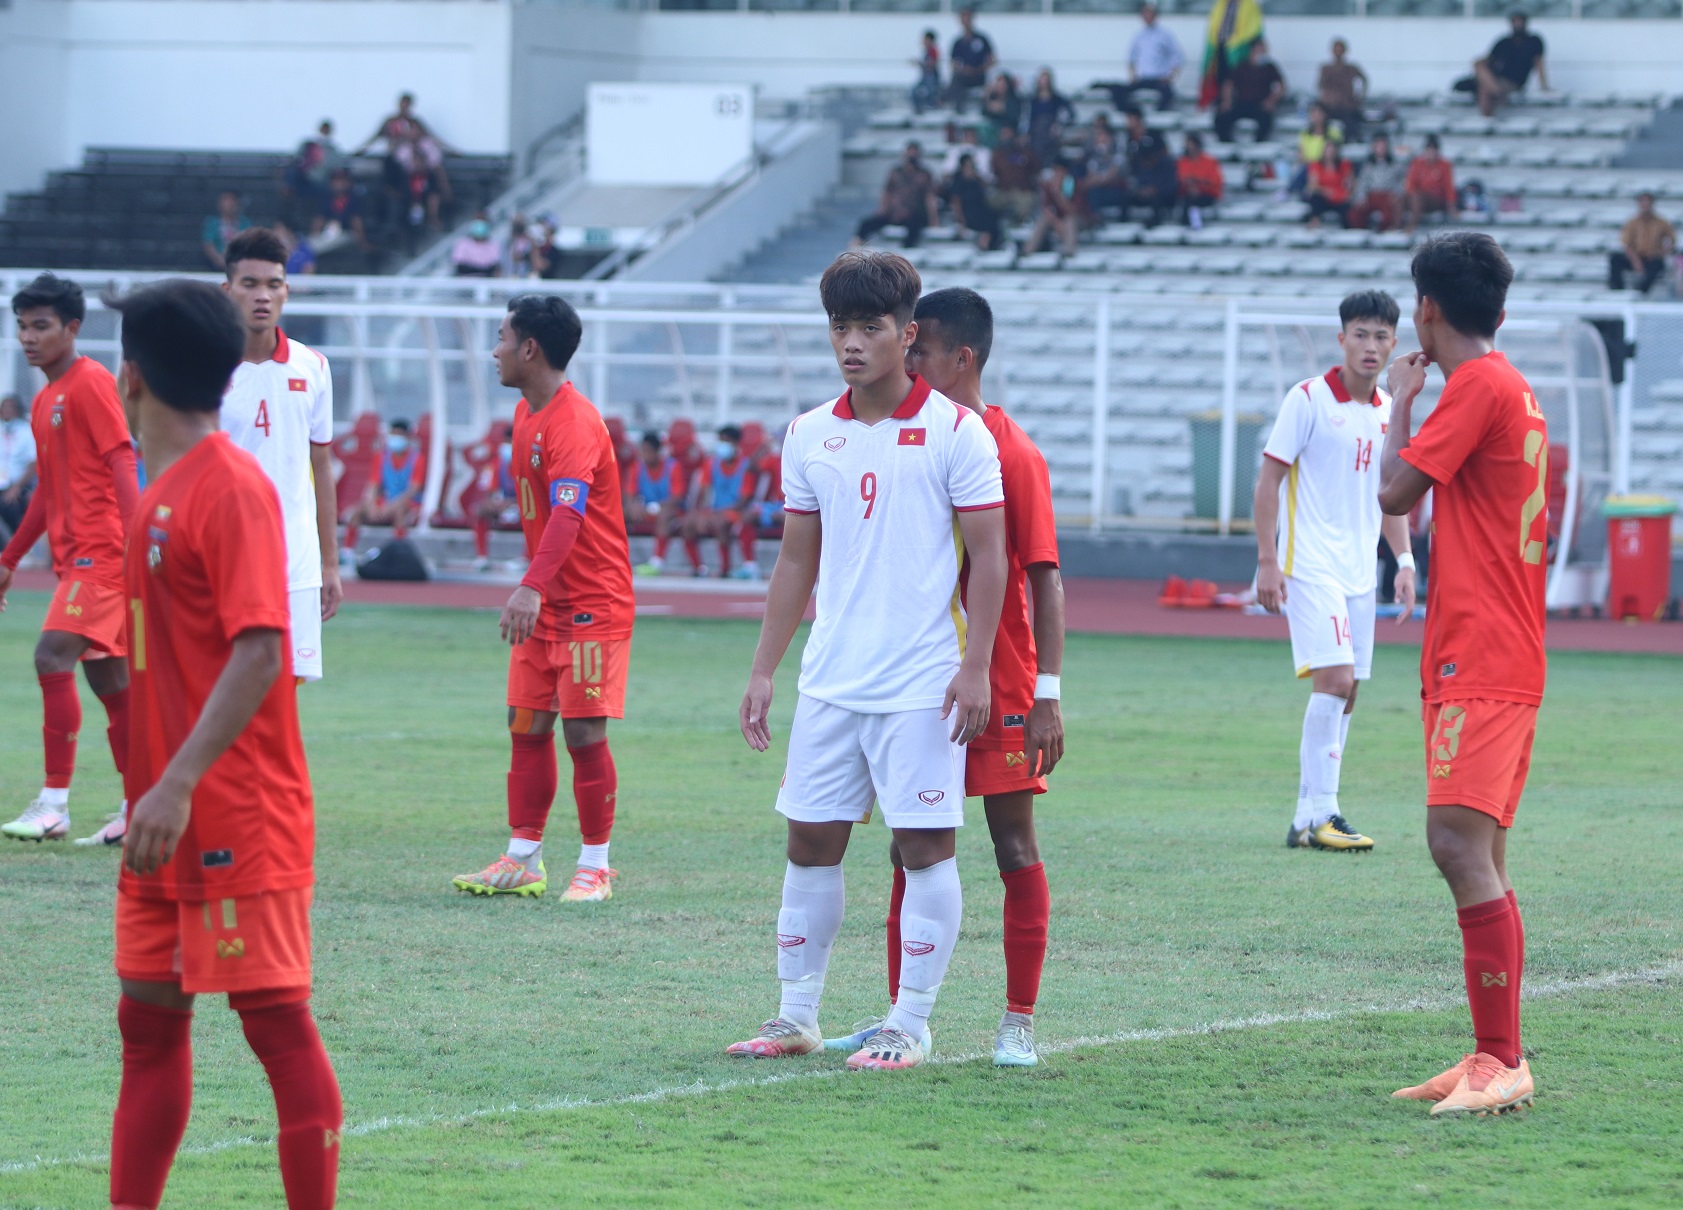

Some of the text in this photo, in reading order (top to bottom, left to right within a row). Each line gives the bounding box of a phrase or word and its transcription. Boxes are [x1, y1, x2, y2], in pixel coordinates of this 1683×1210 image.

[255, 399, 271, 437] 4
[1355, 437, 1372, 472] 14
[861, 471, 877, 519] 9
[1330, 615, 1352, 647] 14
[568, 641, 602, 684] 10
